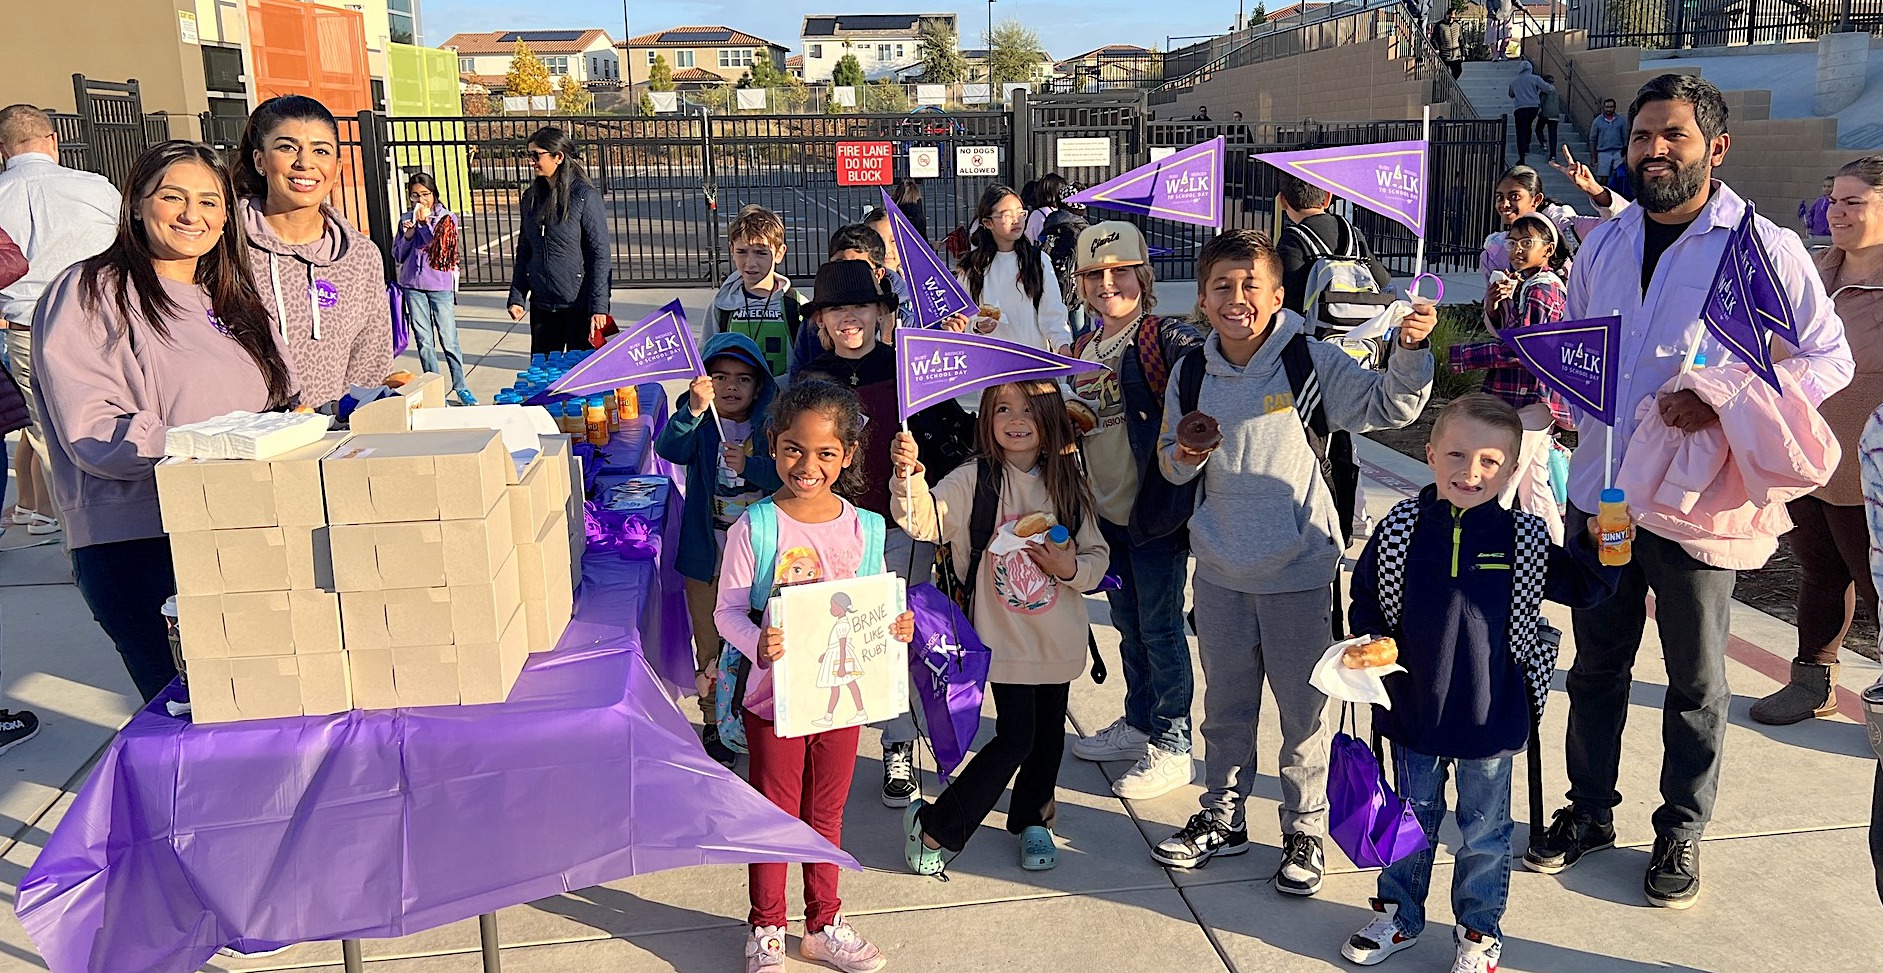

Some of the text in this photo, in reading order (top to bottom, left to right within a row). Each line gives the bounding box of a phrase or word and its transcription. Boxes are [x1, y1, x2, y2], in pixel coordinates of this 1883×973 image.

[838, 146, 889, 156] FIRE LANE
[845, 158, 883, 169] DO NOT
[848, 170, 881, 181] BLOCK
[1166, 170, 1209, 194] WALK
[1376, 164, 1418, 194] WALK
[1389, 189, 1409, 197] SCHOOL
[1090, 232, 1120, 258] Giants
[925, 275, 950, 316] WALK
[628, 336, 680, 362] WALK
[645, 353, 668, 363] SCHOOL
[1561, 342, 1600, 374] WALK
[911, 351, 967, 376] WALK
[926, 372, 951, 380] SCHOOL
[1263, 392, 1293, 414] CAT
[852, 603, 888, 633] BRAVE
[864, 626, 884, 644] LIKE
[862, 640, 887, 662] RUBY
